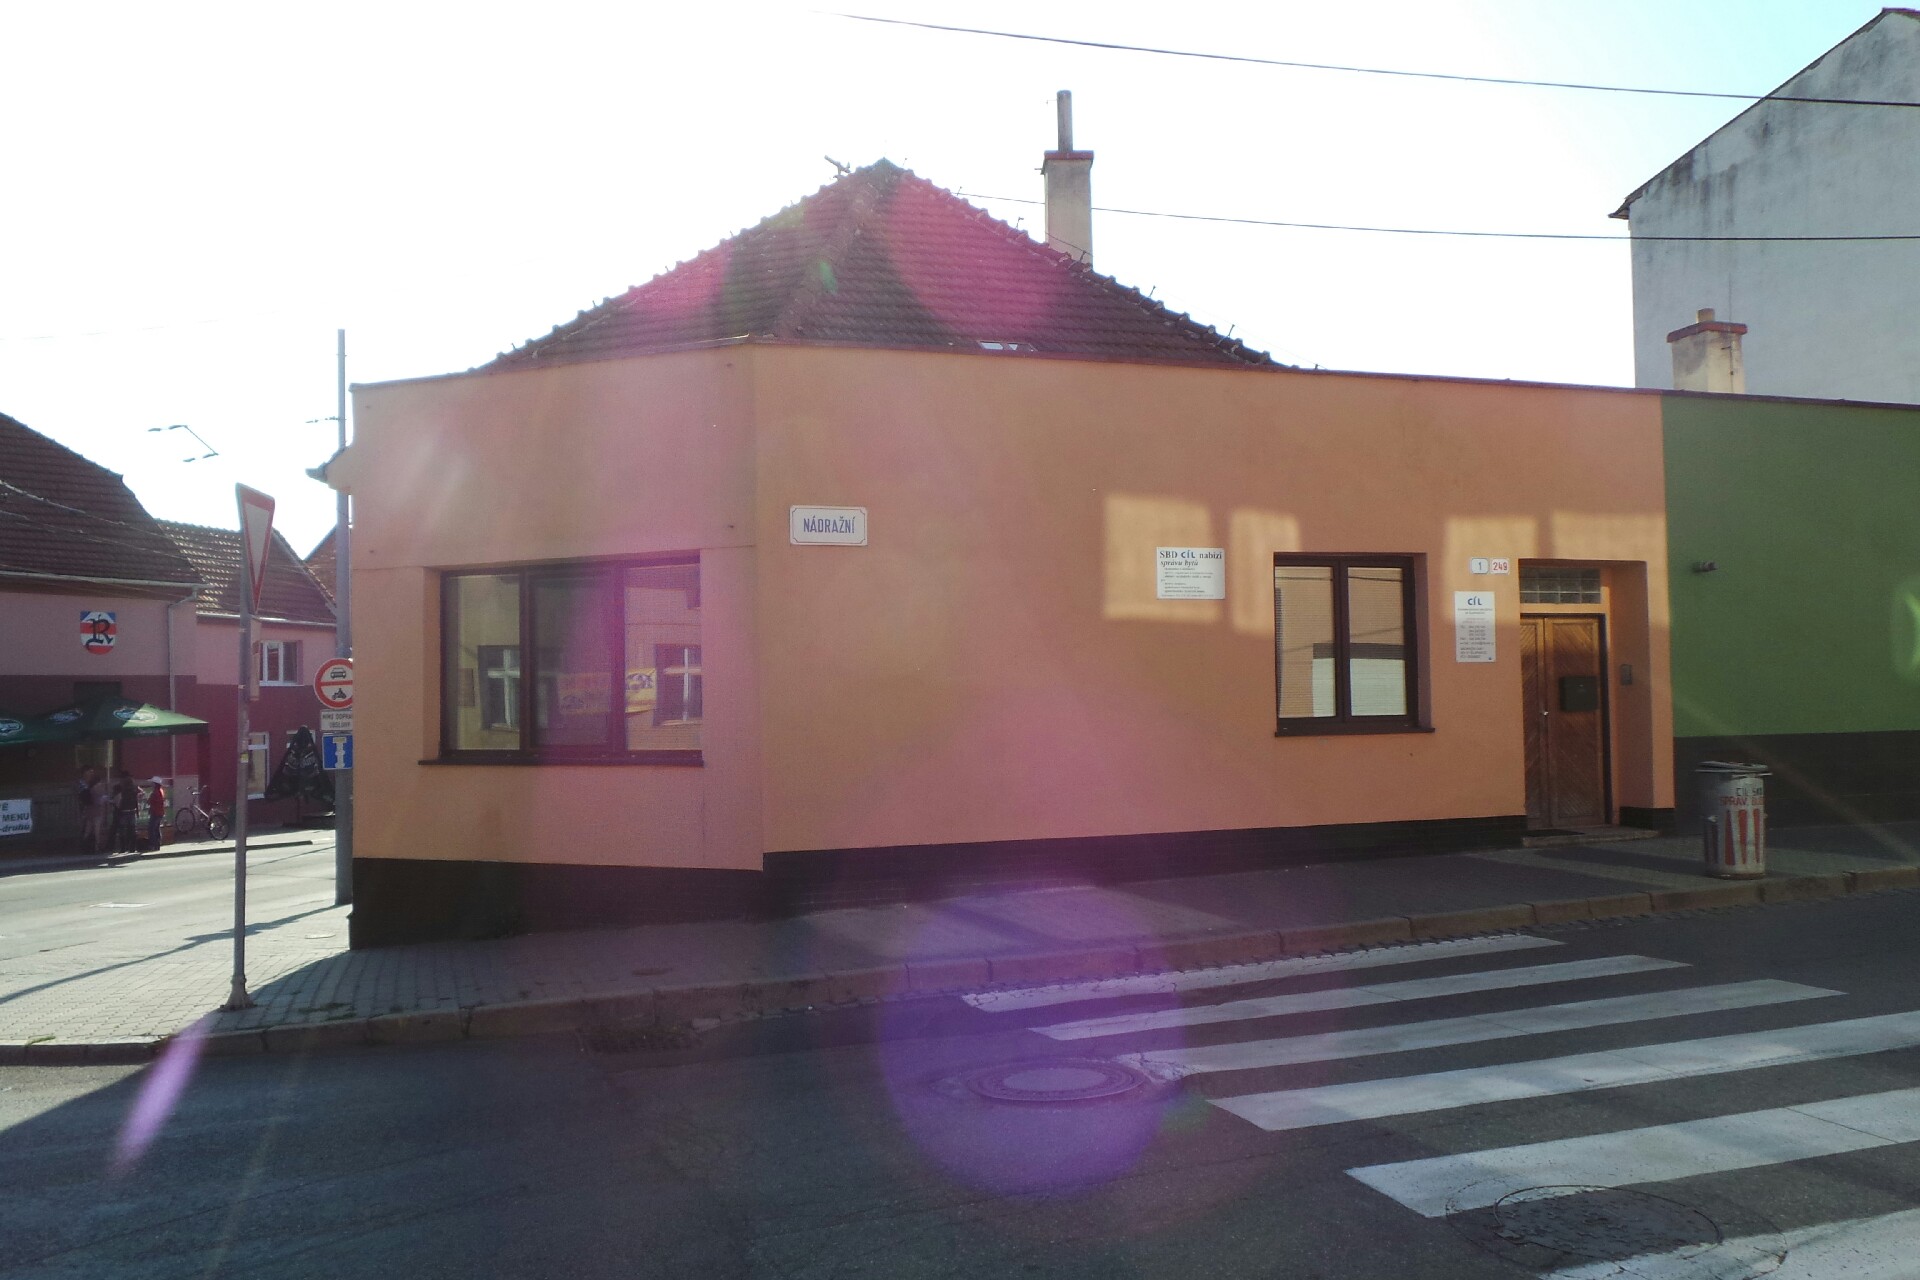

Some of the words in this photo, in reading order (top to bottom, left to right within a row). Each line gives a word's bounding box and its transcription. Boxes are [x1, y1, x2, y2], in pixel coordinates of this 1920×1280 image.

[803, 515, 855, 533] NÁDRAŽNÍ
[1160, 550, 1177, 559] SBD
[1181, 550, 1196, 559] CÍL
[1493, 562, 1508, 571] 249
[1467, 596, 1483, 606] CÍL
[3, 813, 30, 821] MENU
